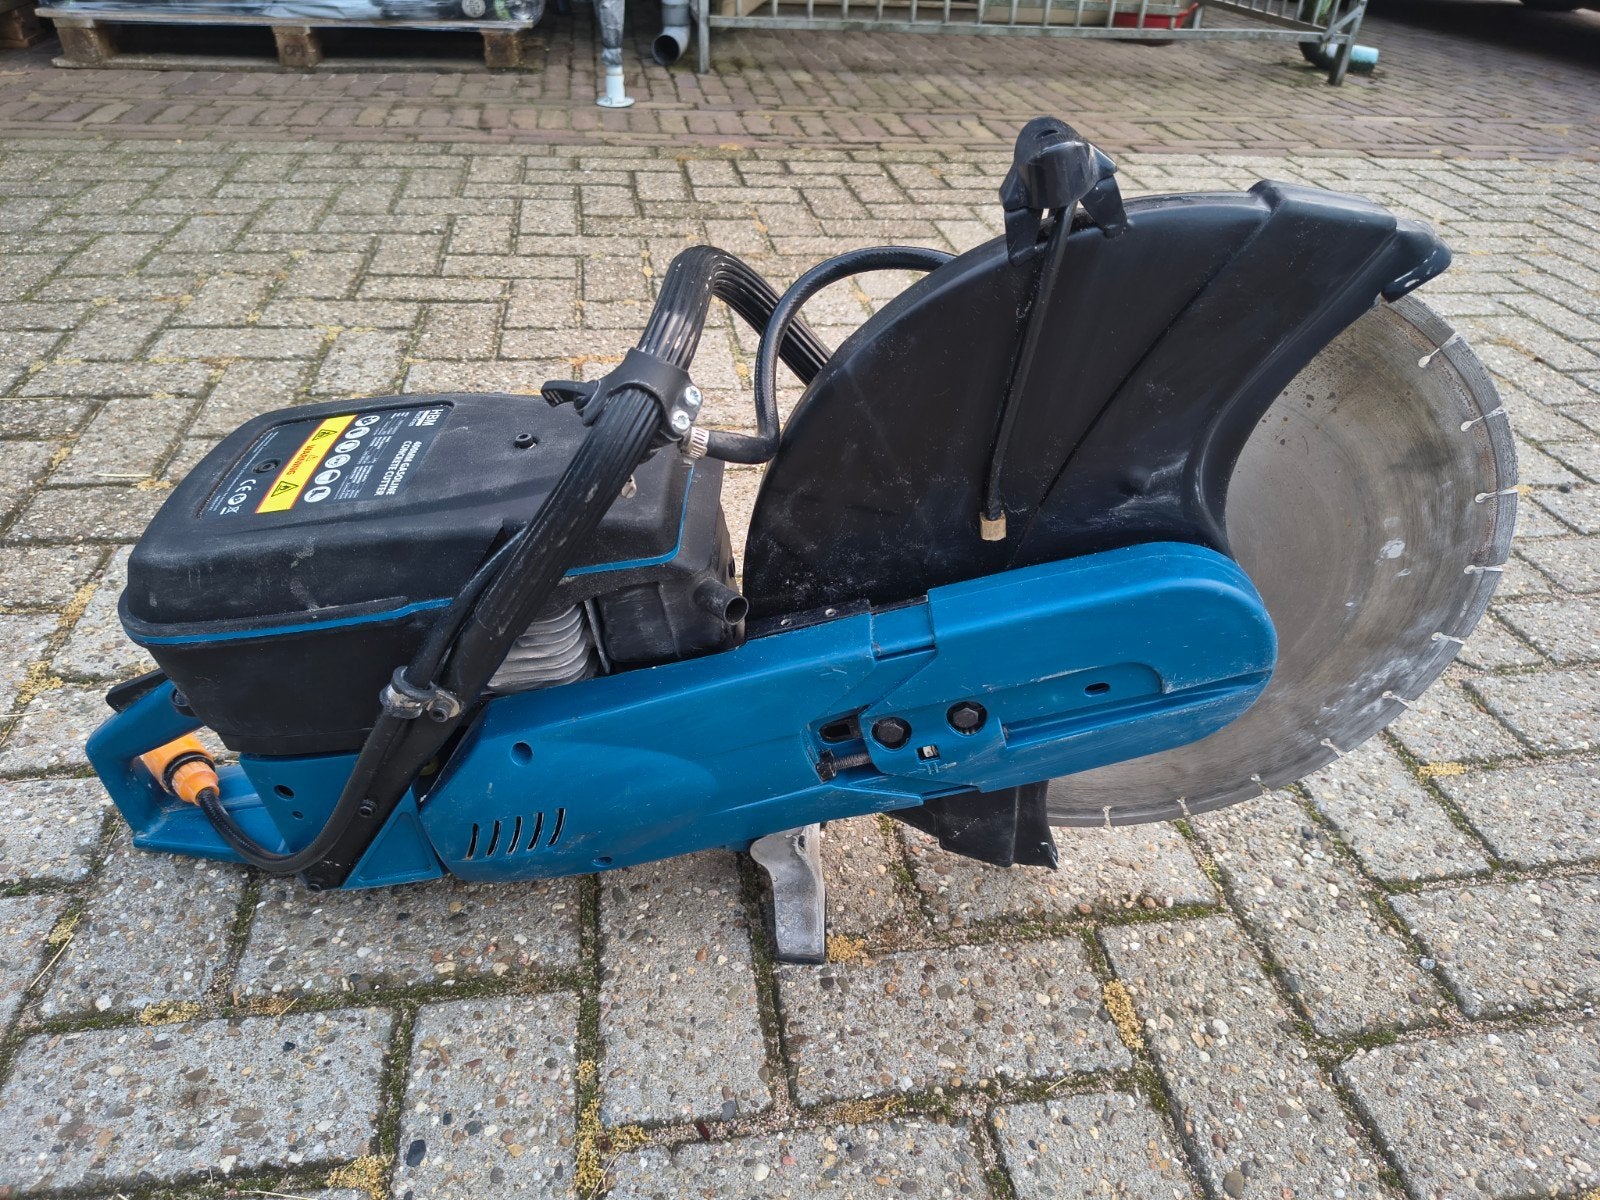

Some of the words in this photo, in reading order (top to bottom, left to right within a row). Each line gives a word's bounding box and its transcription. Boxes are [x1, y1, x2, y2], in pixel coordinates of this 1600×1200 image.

[421, 409, 443, 426] HBM
[286, 444, 316, 475] WARNING
[387, 440, 412, 470] CONCRETE
[374, 470, 395, 496] CUTTER
[385, 462, 410, 495] GASOLINE
